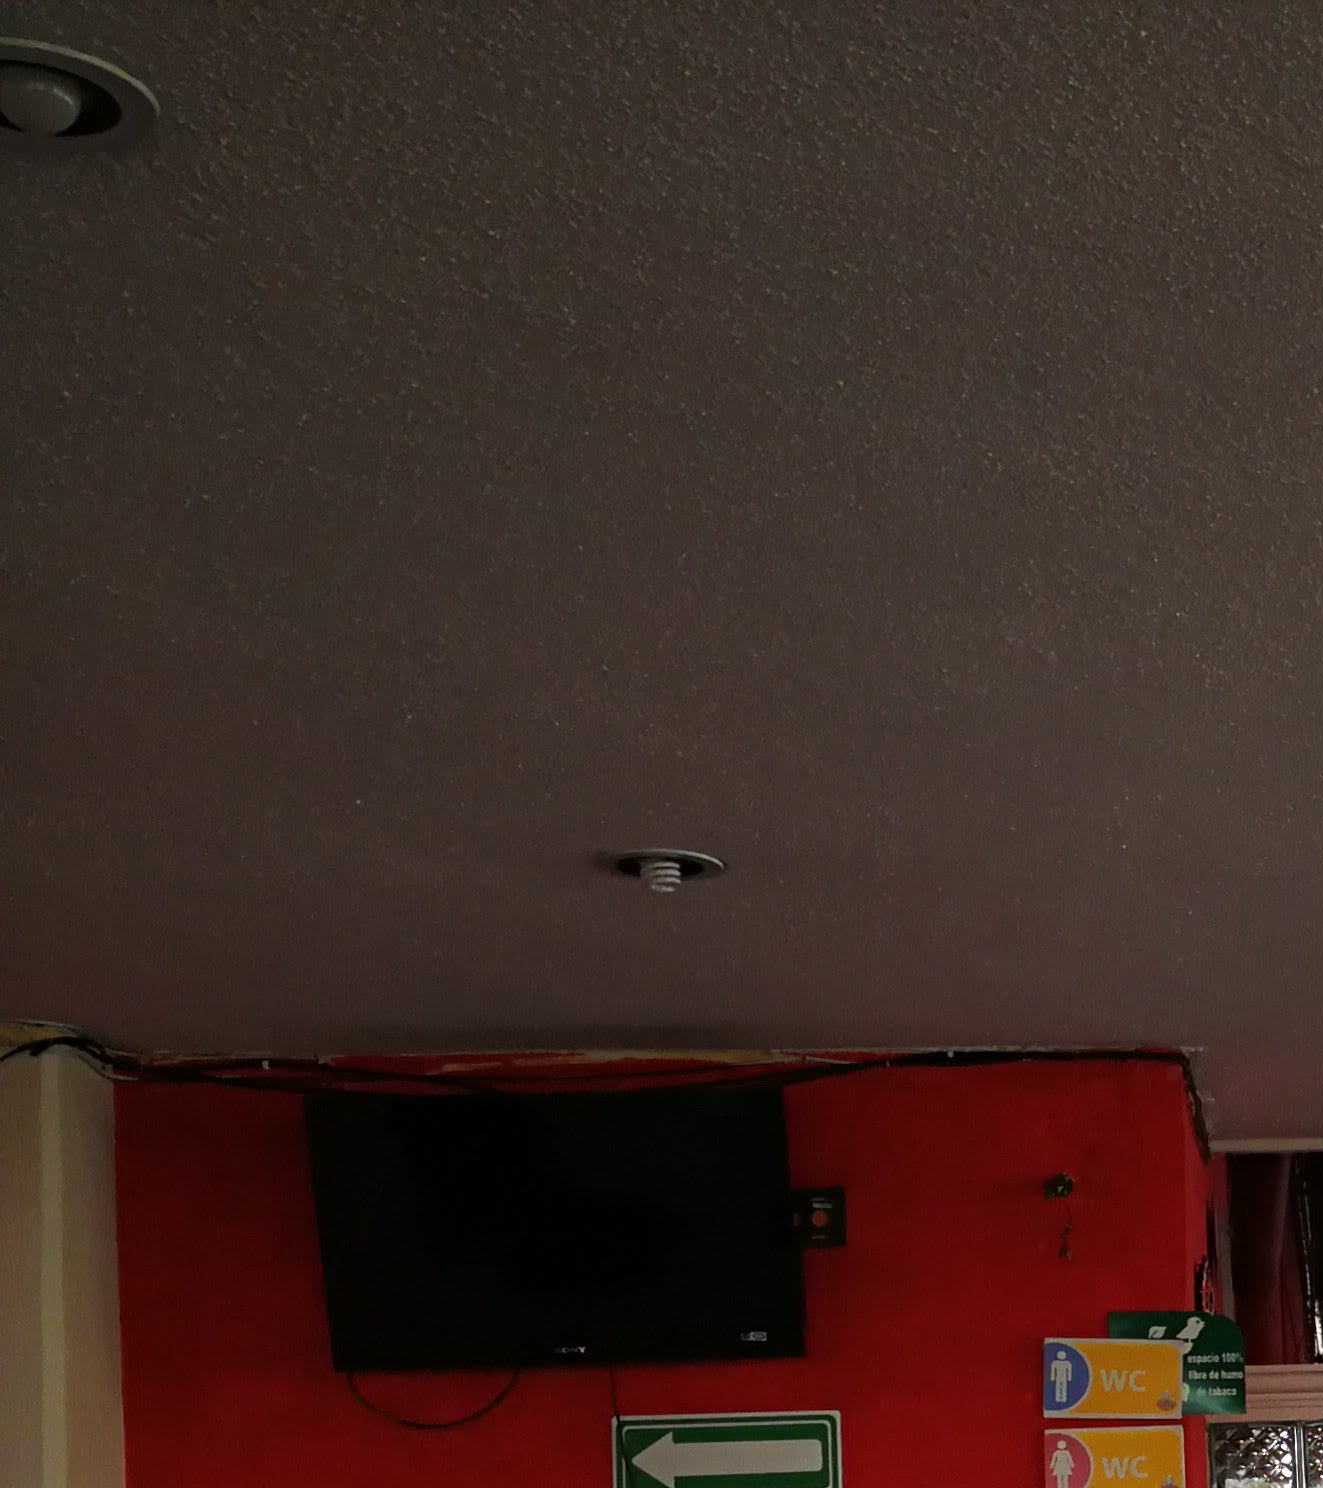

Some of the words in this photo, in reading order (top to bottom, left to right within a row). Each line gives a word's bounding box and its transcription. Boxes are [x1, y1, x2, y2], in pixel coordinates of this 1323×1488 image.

[1187, 1353, 1219, 1365] espacio
[1101, 1369, 1146, 1392] WC
[1208, 1370, 1219, 1379] de
[1220, 1370, 1243, 1379] humo
[1208, 1386, 1237, 1396] tabaco
[1102, 1456, 1148, 1479] WC
